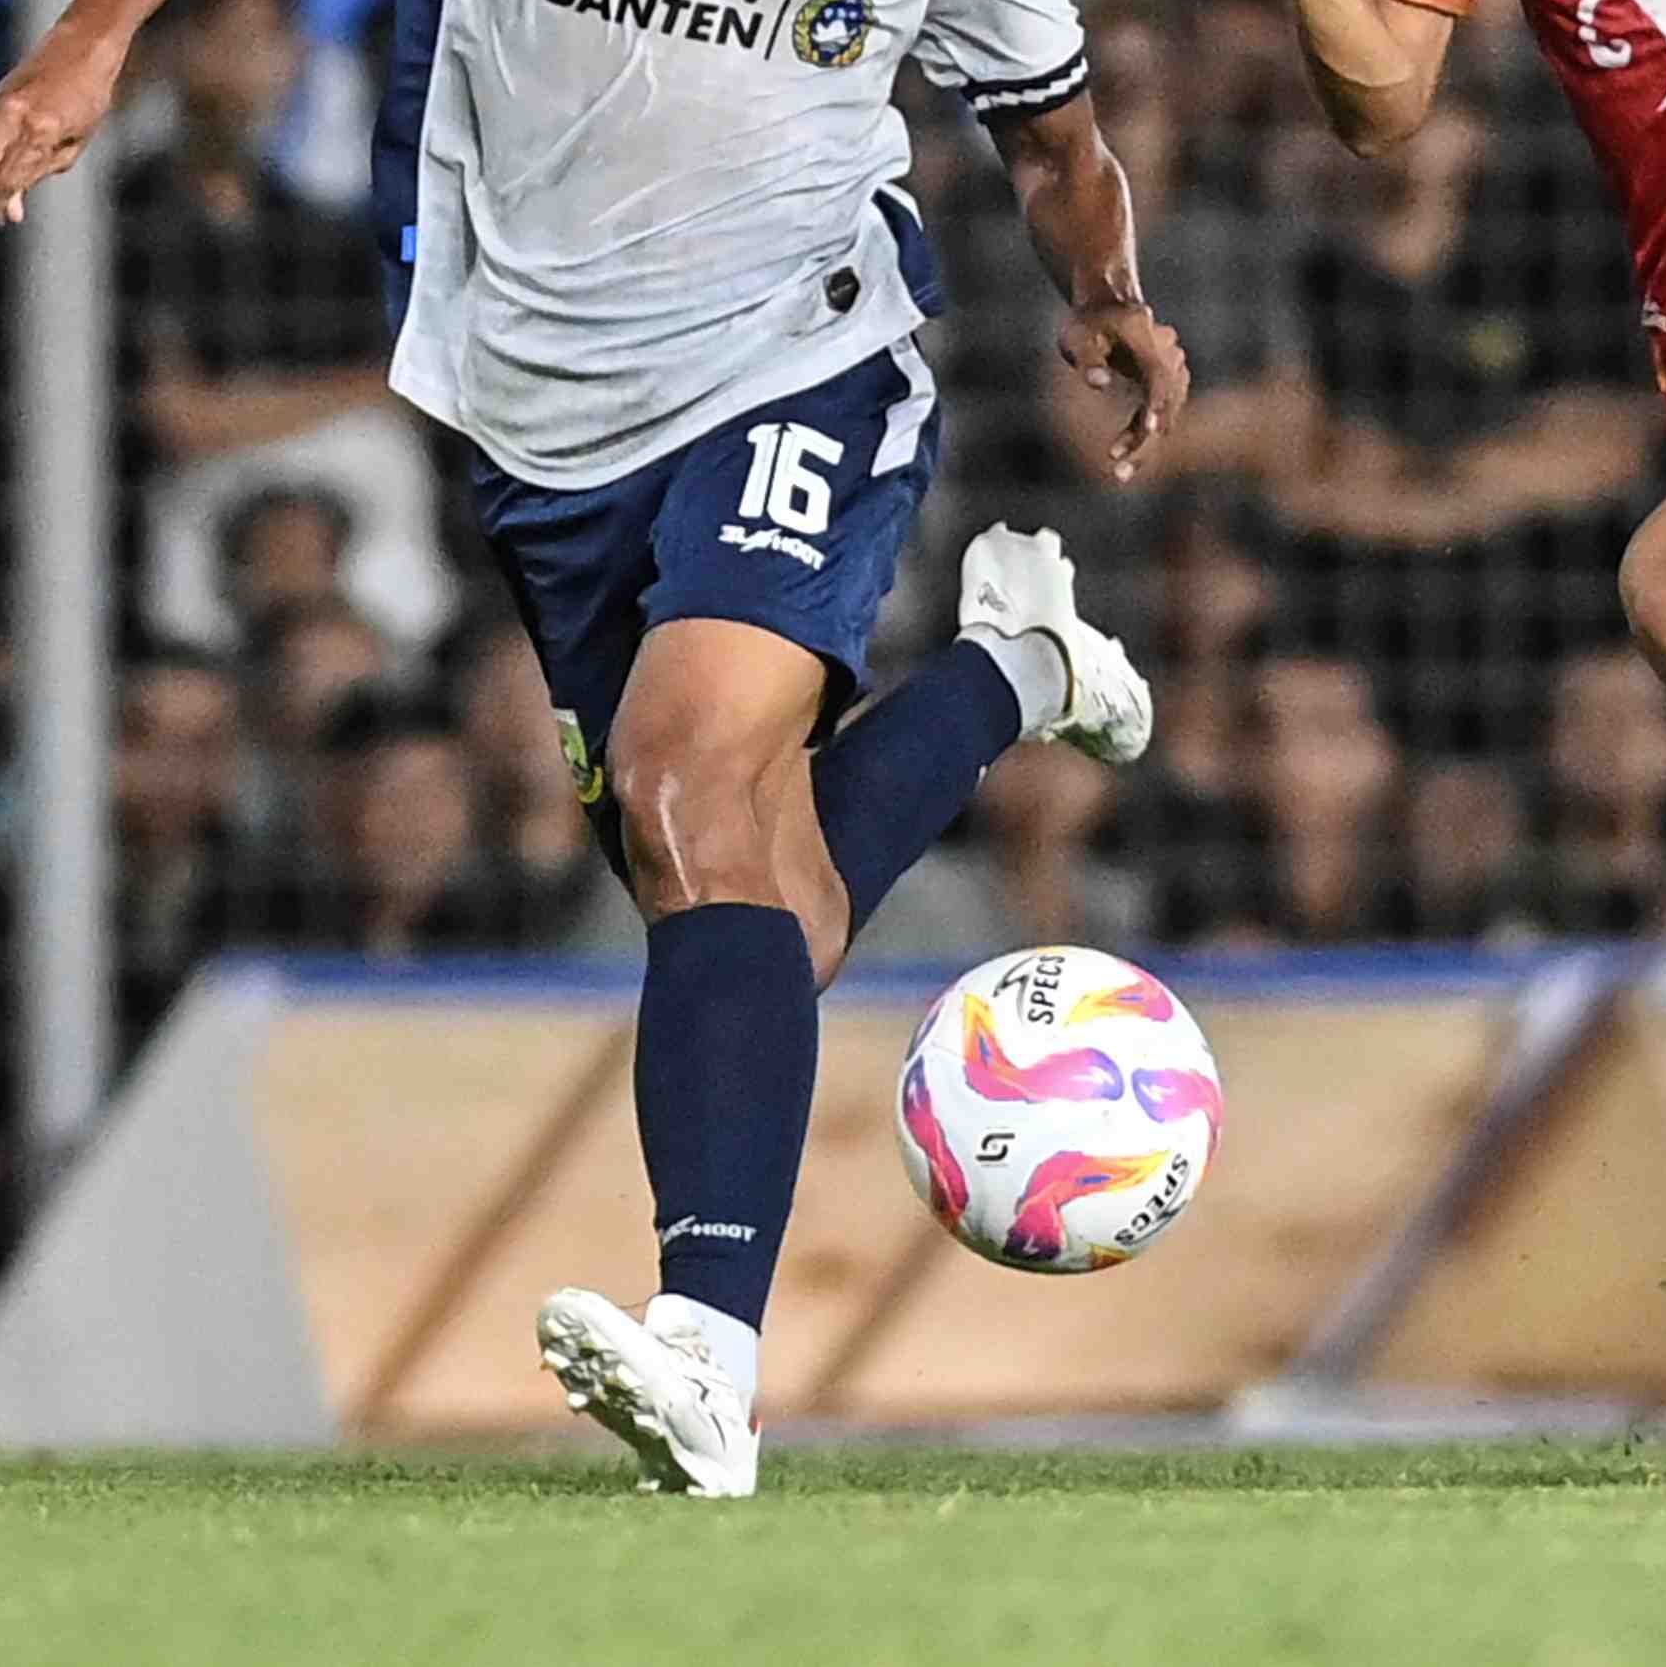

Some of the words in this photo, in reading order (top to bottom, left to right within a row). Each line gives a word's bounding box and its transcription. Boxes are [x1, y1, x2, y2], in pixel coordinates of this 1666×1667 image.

[738, 421, 845, 535] 16
[1027, 955, 1066, 1025] SPECS
[1114, 1152, 1189, 1246] SPECS
